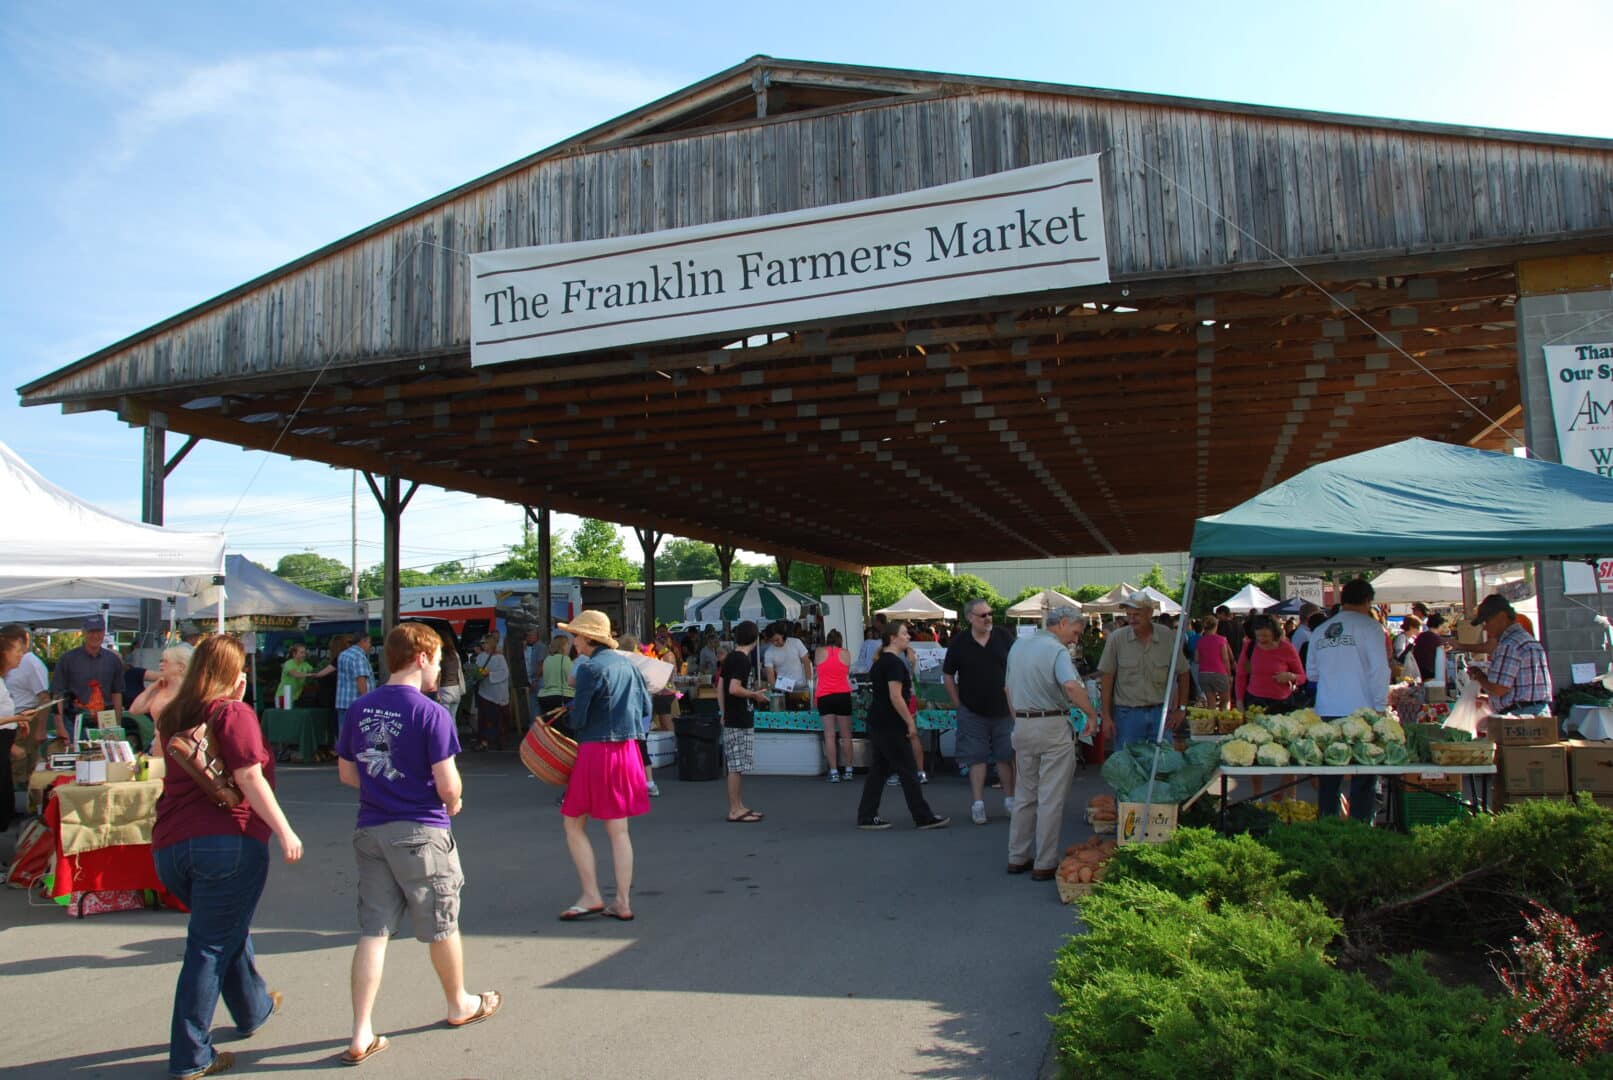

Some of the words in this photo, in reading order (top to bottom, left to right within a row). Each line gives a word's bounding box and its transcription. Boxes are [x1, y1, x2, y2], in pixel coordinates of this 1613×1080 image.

[484, 286, 549, 326] The
[561, 259, 726, 315] Franklin
[737, 239, 912, 291] Farmers
[925, 206, 1089, 263] Market
[1560, 368, 1594, 383] Our
[421, 594, 483, 608] U-HAUL
